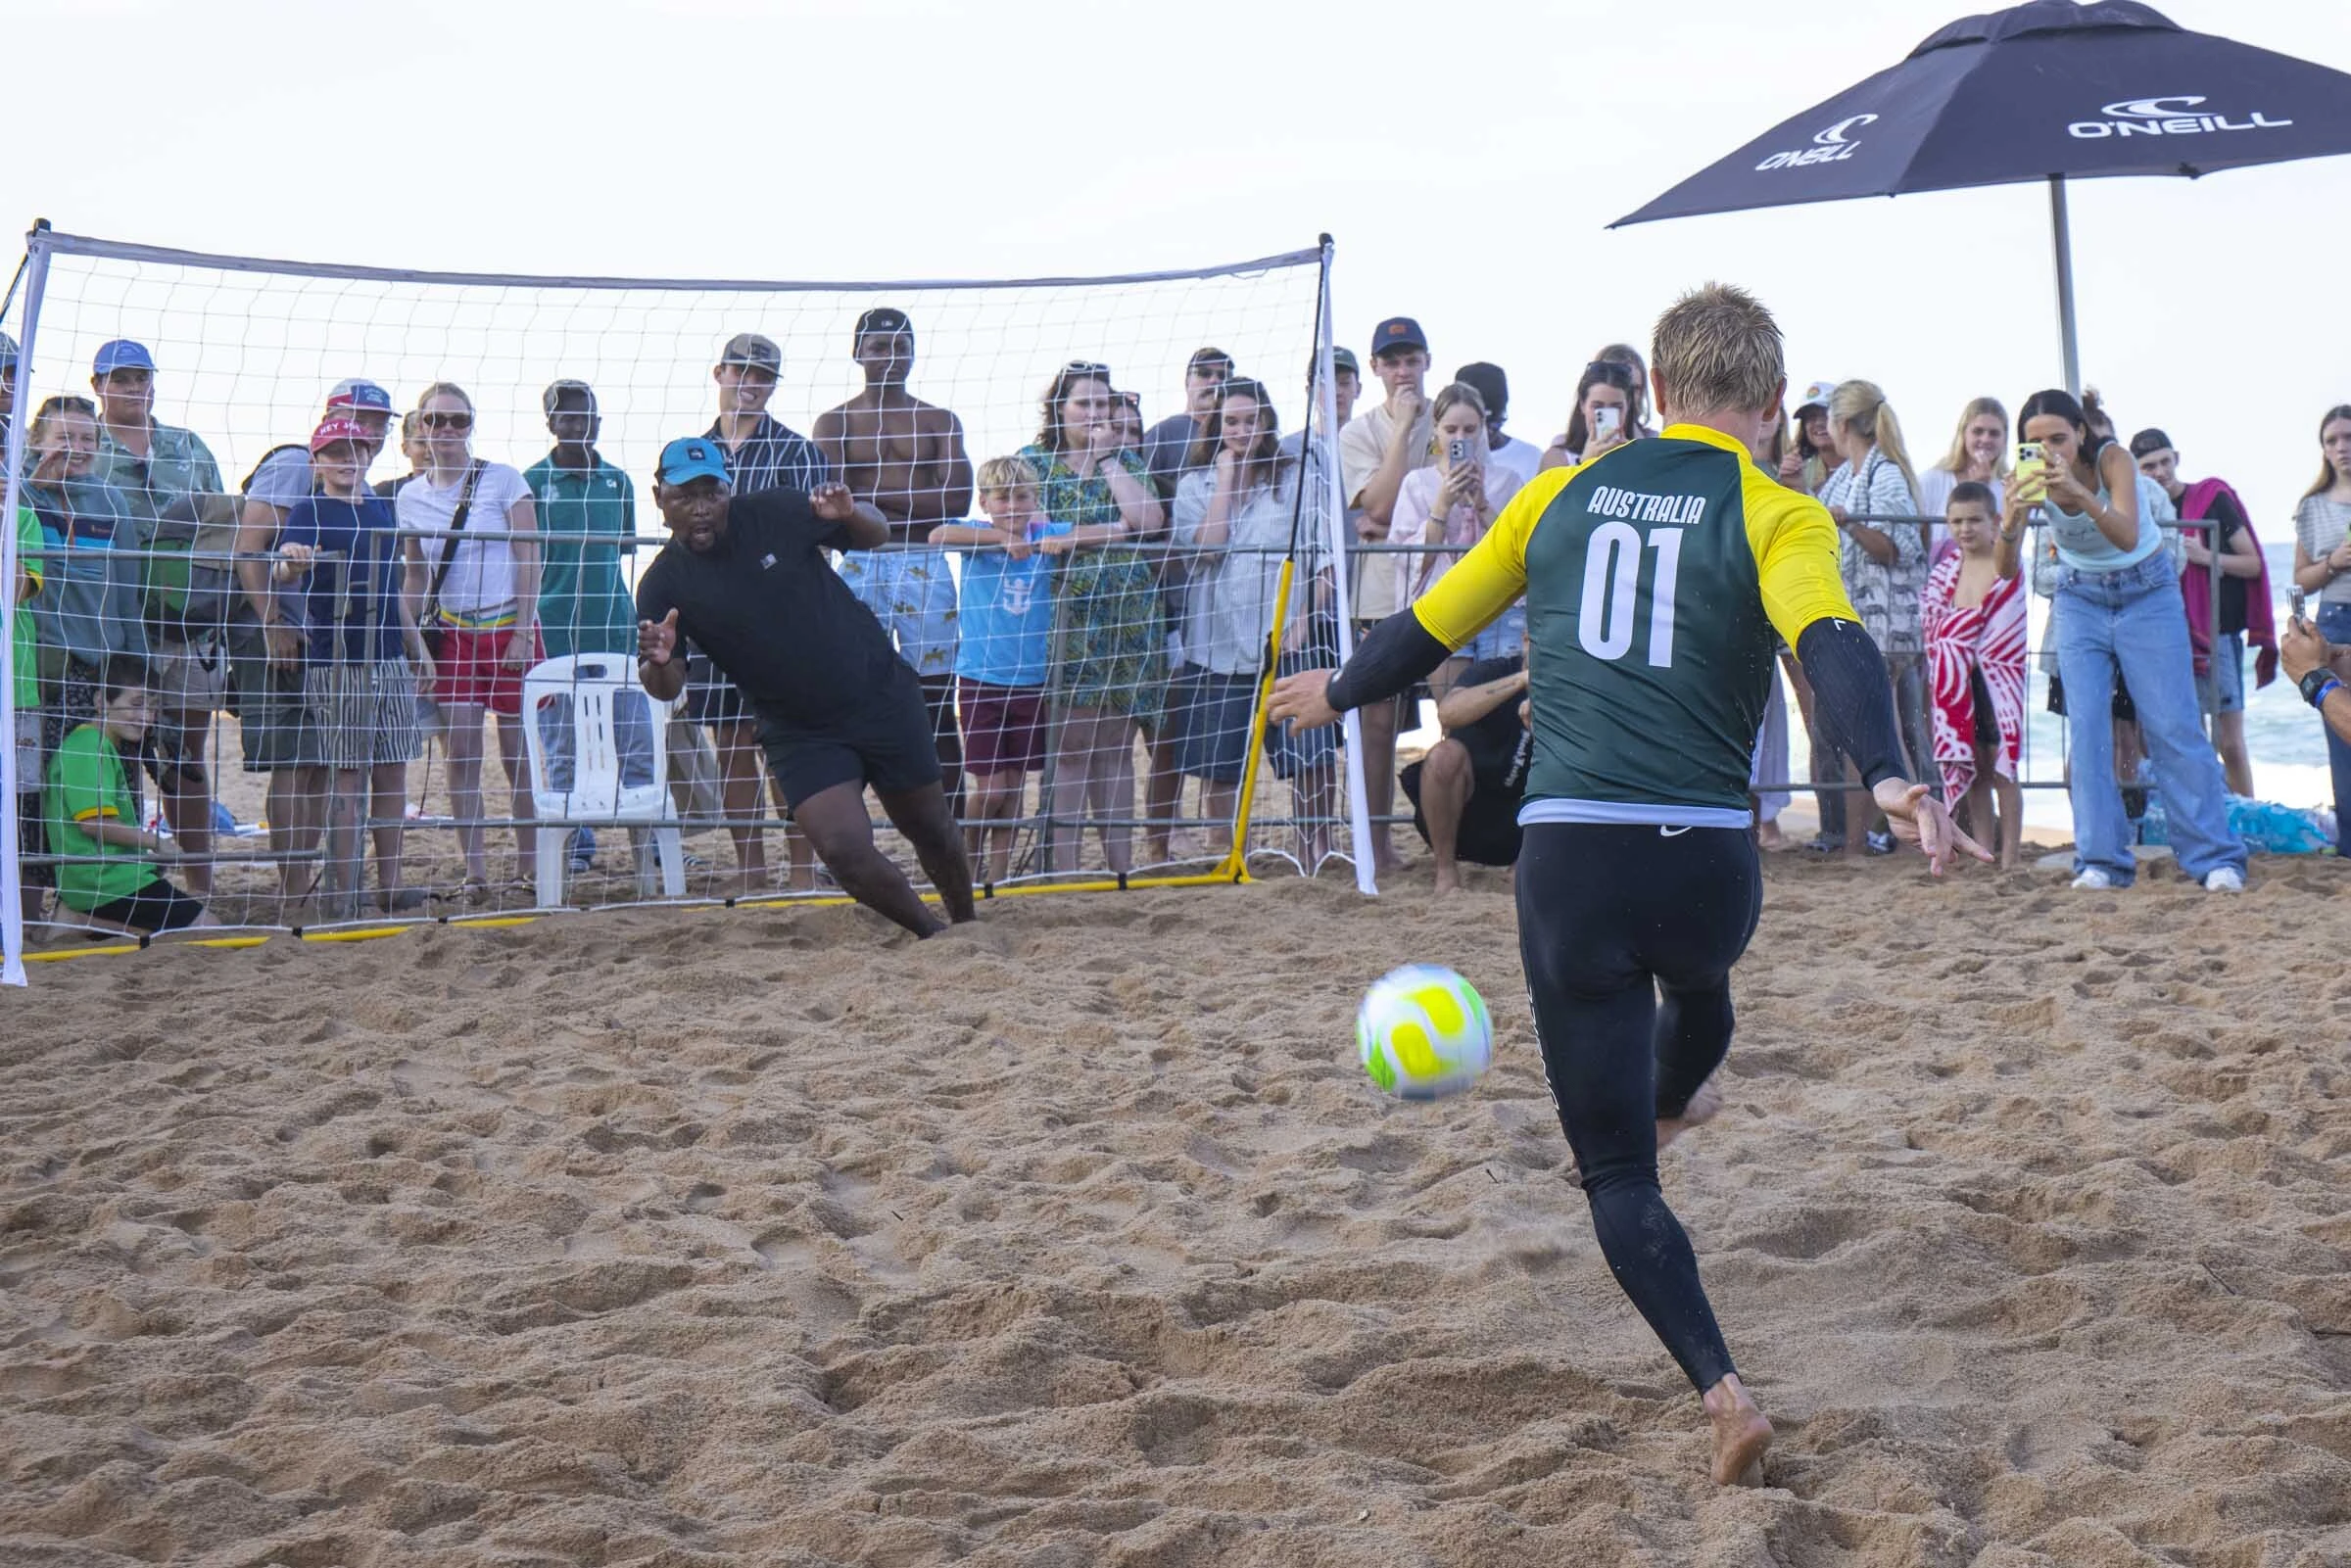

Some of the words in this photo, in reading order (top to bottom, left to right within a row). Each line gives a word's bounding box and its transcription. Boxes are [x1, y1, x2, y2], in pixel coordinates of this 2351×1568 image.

[2068, 112, 2293, 138] O'NEILL
[1587, 486, 1706, 524] AUSTRALIA
[1578, 521, 1684, 668] 01
